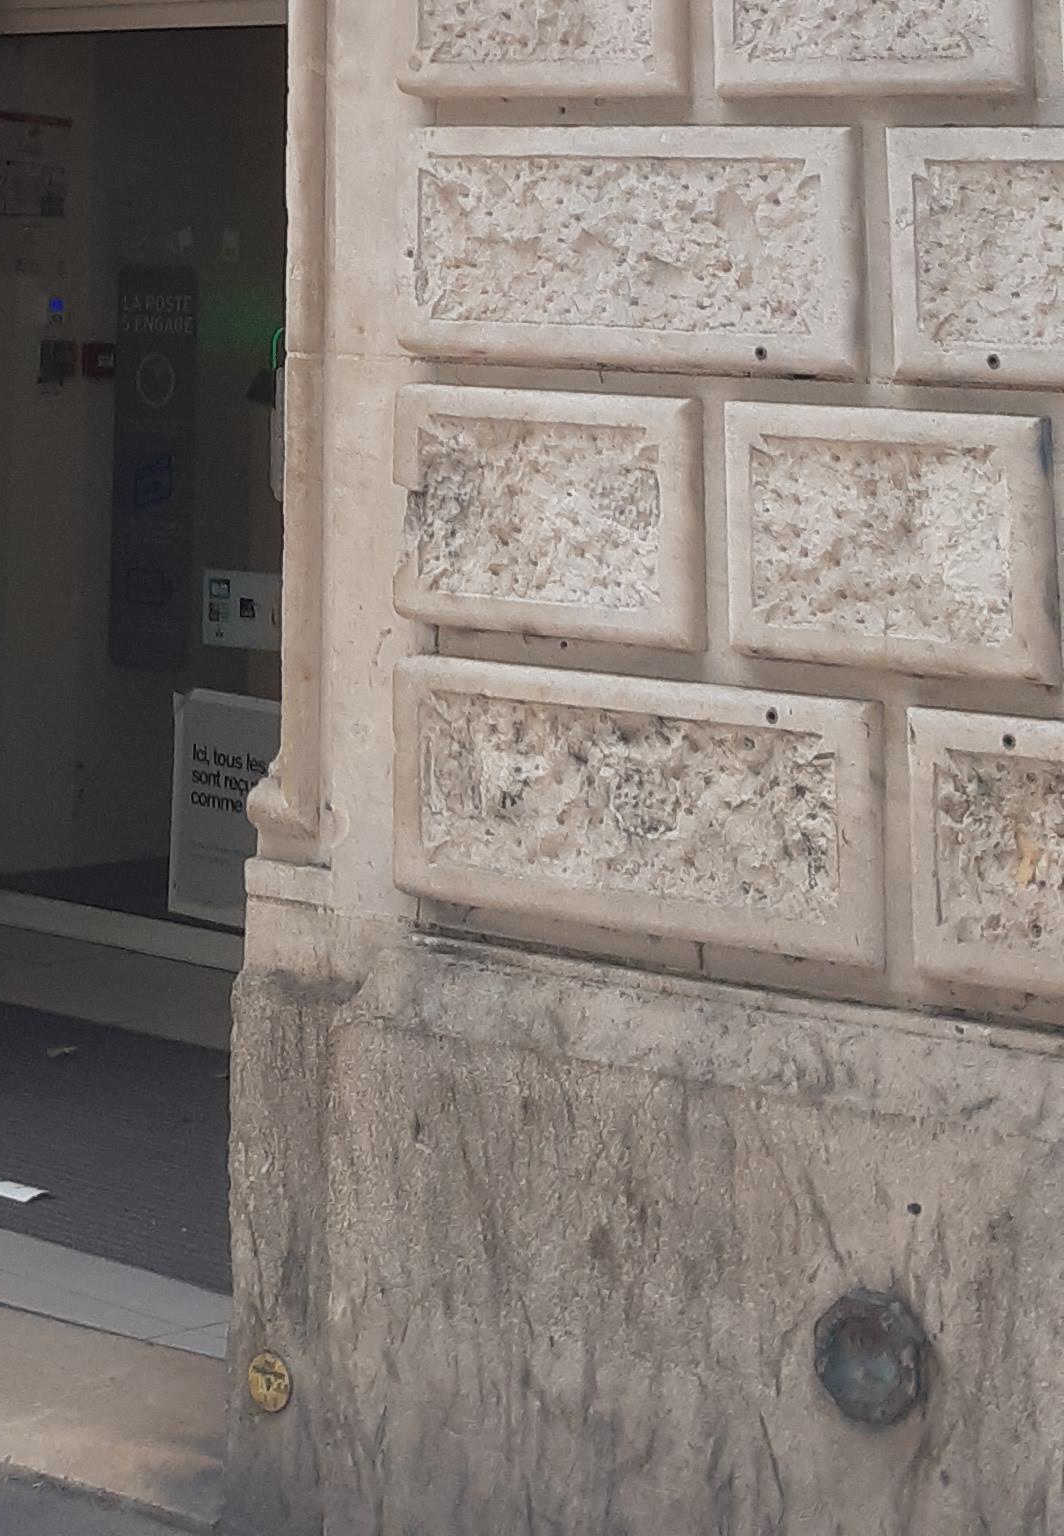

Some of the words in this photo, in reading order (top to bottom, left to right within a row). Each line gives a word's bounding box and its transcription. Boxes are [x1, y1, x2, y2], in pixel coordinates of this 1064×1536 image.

[192, 743, 209, 767] Ici,
[213, 747, 243, 770] tous
[246, 753, 266, 775] les
[192, 769, 220, 787] sont
[191, 791, 243, 813] comme
